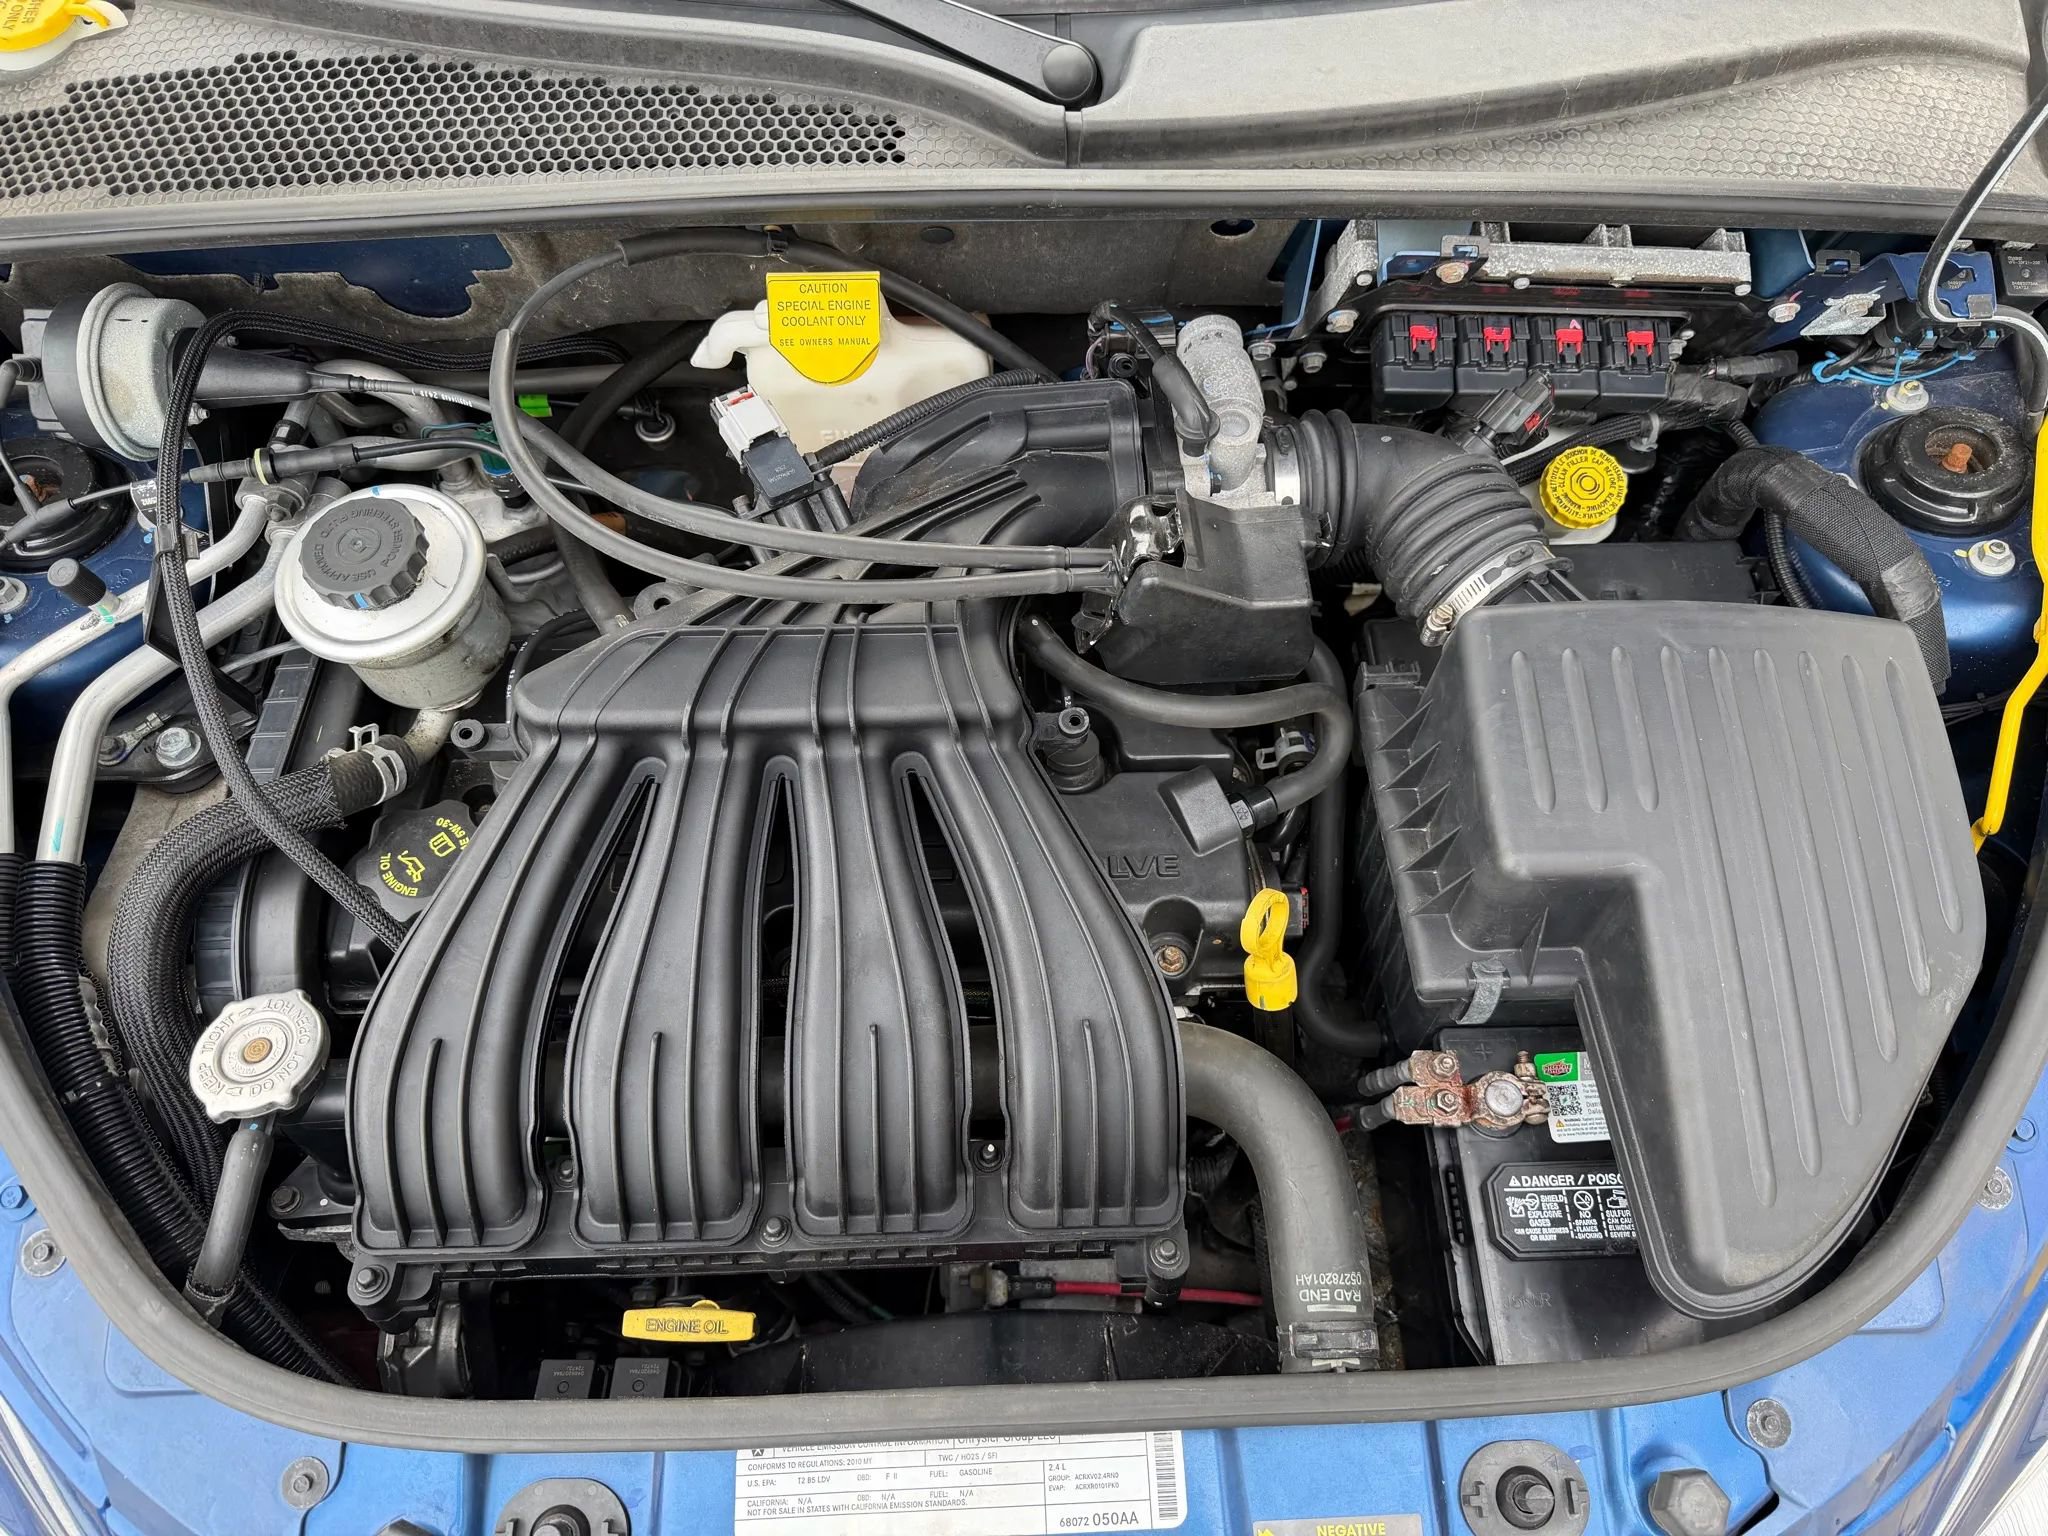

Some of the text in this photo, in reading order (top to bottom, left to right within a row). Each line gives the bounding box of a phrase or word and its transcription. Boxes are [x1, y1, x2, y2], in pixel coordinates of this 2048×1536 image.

[3, 4, 24, 31] ONLY
[799, 283, 848, 294] CAUTION
[777, 299, 871, 312] SPECIAL ENGINE
[781, 315, 866, 327] COOLANT ONLY
[779, 337, 871, 347] SEE OWNERS MANUAL
[1567, 456, 1588, 469] FILLER
[1592, 457, 1604, 466] CAP
[1604, 466, 1616, 489] BEFORE
[382, 530, 403, 568] POWER
[314, 543, 352, 582] APPROVED
[435, 817, 466, 839] 5W-30
[380, 852, 419, 897] ENGINE OIL
[263, 998, 295, 1014] HOT
[295, 1009, 312, 1045] OPEN
[199, 1012, 236, 1095] KEEP TIGHT
[275, 1050, 304, 1082] NOT
[249, 1078, 275, 1097] DO
[1521, 1174, 1575, 1187] DANGER
[1577, 1174, 1585, 1185] /
[1540, 1194, 1564, 1202] SHIELD
[1542, 1202, 1559, 1210] EYES
[1527, 1210, 1563, 1218] EXPLOSIVE
[1579, 1210, 1591, 1218] NO
[1529, 1219, 1551, 1227] GASES
[1295, 1271, 1362, 1287] 05278201AH
[1299, 1288, 1362, 1302] RAD END
[645, 1317, 729, 1335] ENGINE OIL
[747, 1463, 786, 1471] CONFORMS
[797, 1459, 846, 1468] REGULATIONS:
[847, 1458, 862, 1466] 2010
[938, 1454, 953, 1462] TWC
[1048, 1463, 1060, 1471] 2.4
[747, 1479, 760, 1488] U.S.
[762, 1479, 777, 1487] EPA:
[797, 1477, 806, 1485] T2
[817, 1475, 831, 1484] LDV
[857, 1473, 872, 1481] OBD:
[929, 1470, 948, 1478] FUEL:
[959, 1468, 993, 1476] GASOLINE
[1048, 1474, 1070, 1482] GROUP:
[747, 1499, 789, 1508] CALIFORNIA:
[797, 1497, 812, 1505] N/A
[881, 1493, 896, 1501] N/A
[959, 1489, 974, 1497] N/A
[747, 1498, 968, 1516] NOT FOR SALE IN STATES WITH CALIFORNIA EMISSION STANDARDS.
[1059, 1511, 1139, 1528] 68072 050AA
[1316, 1522, 1386, 1536] NEGATIVE
